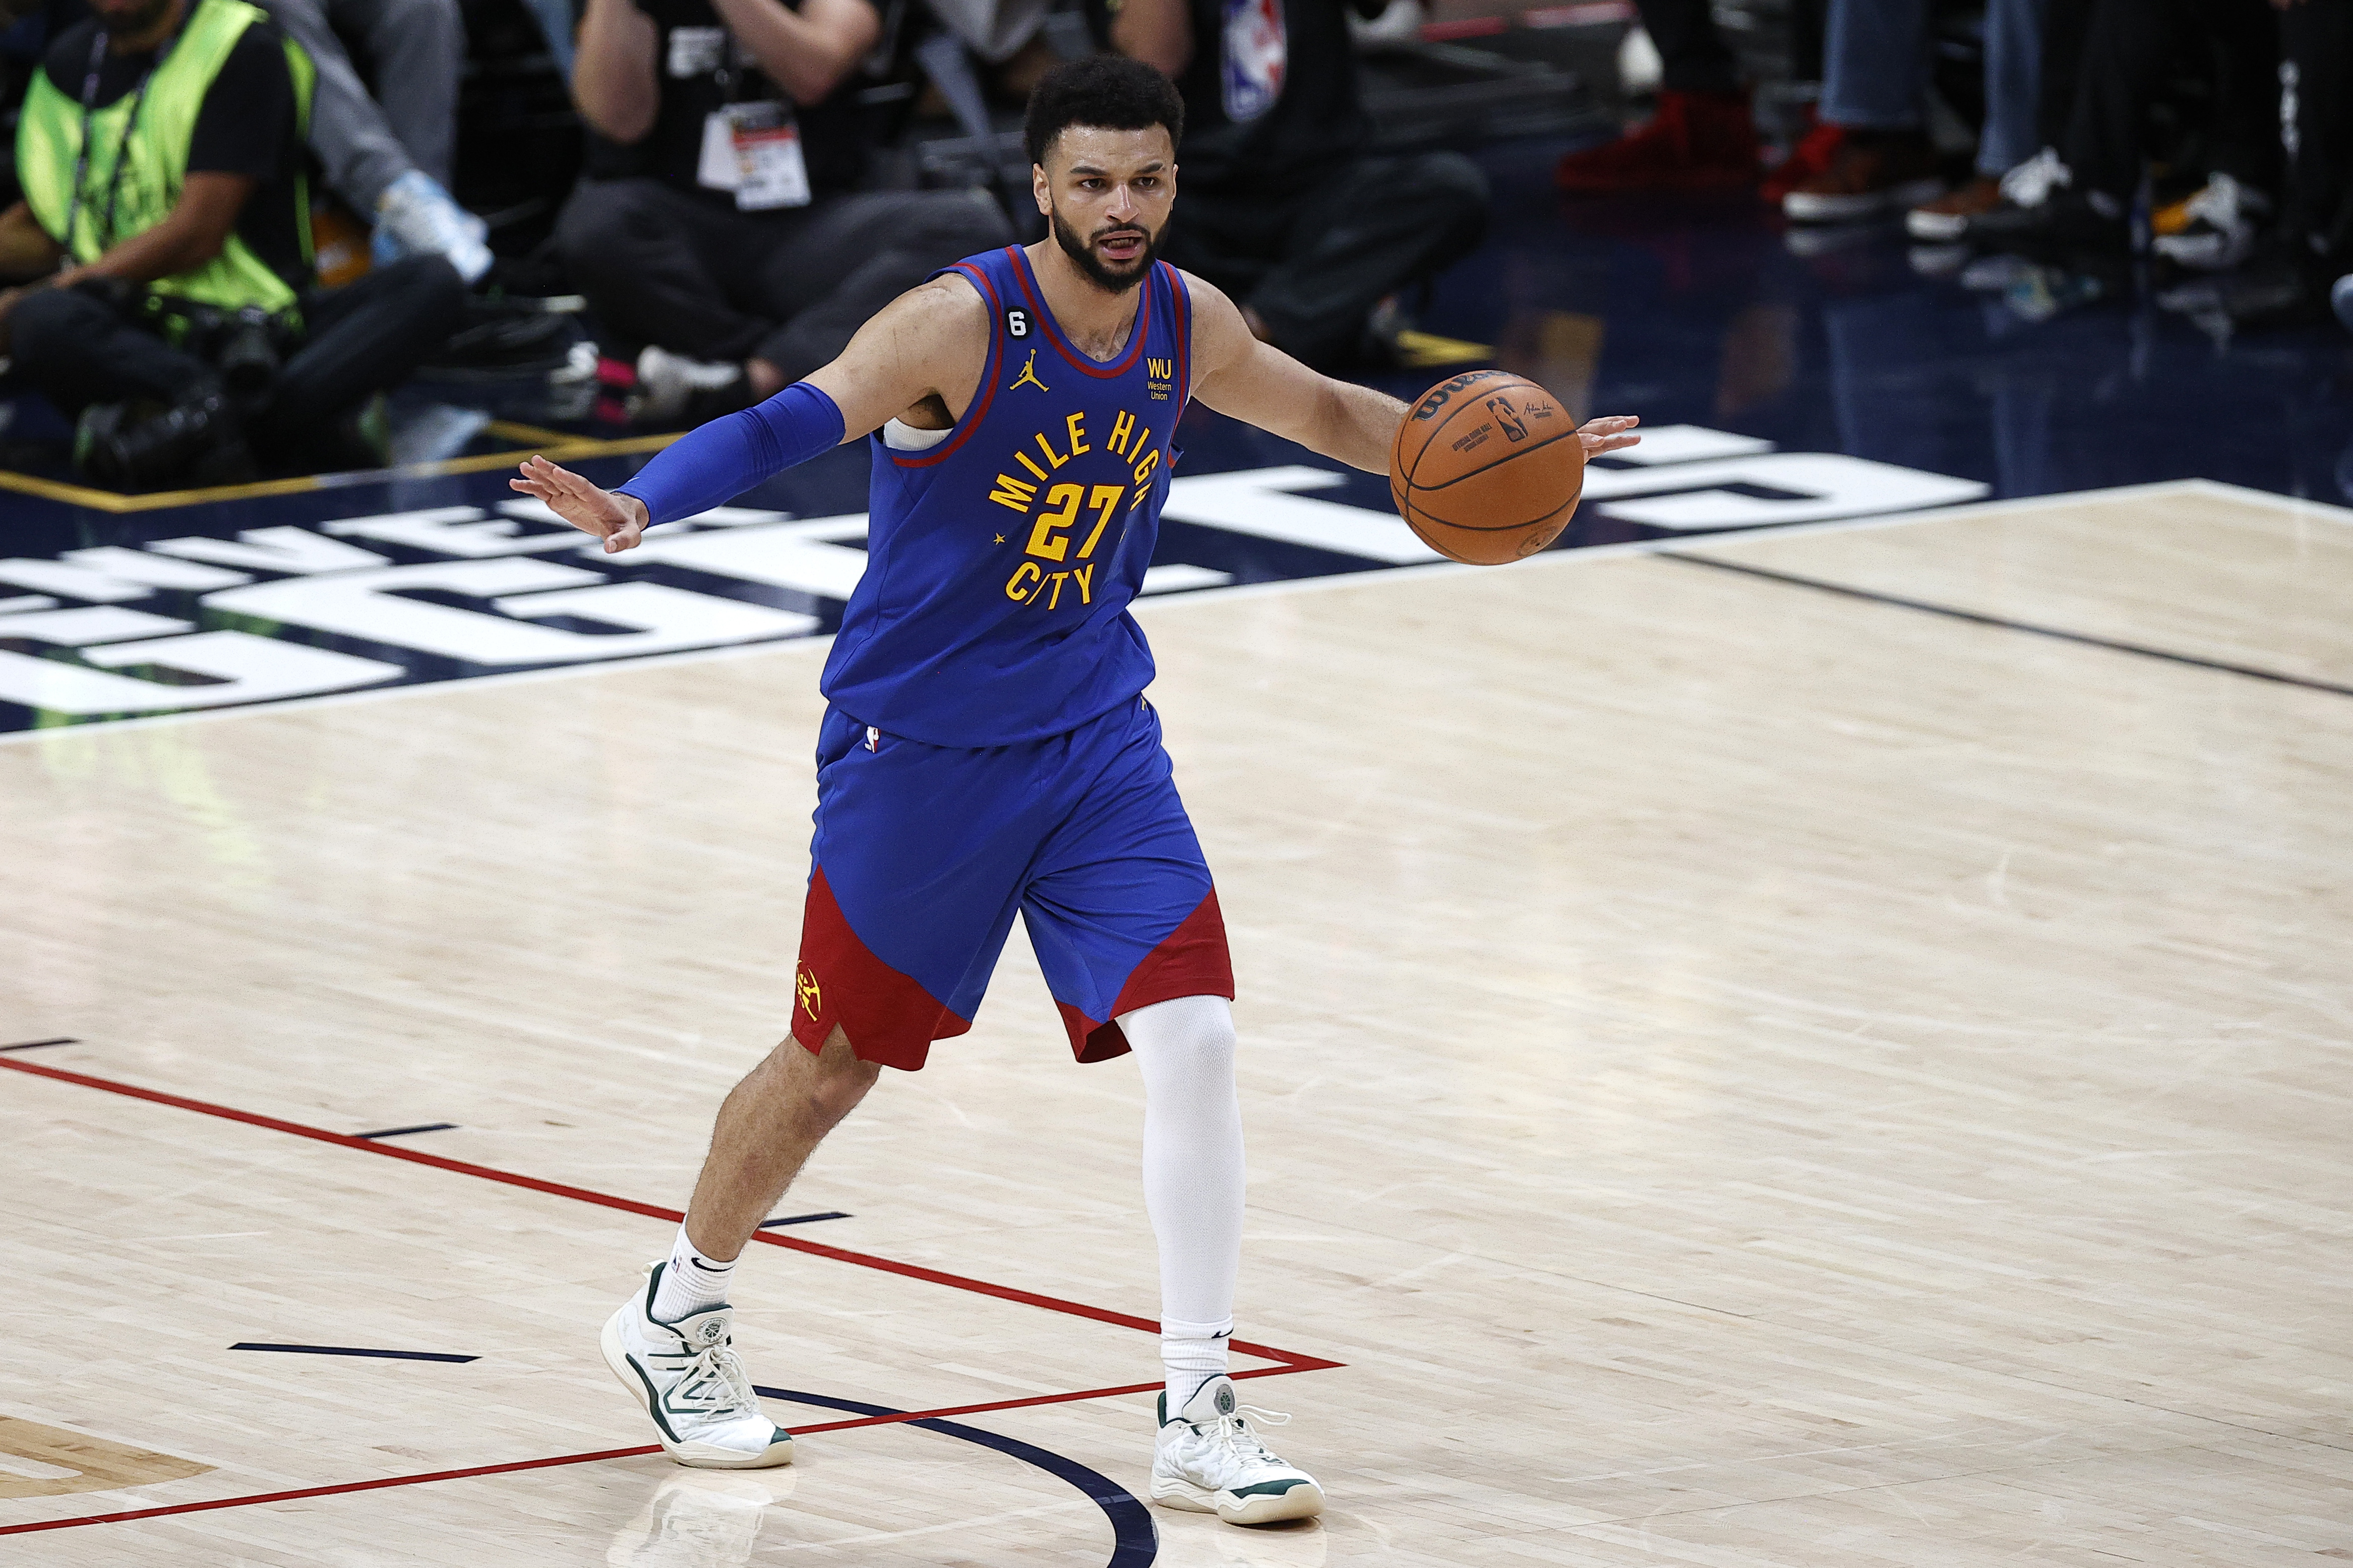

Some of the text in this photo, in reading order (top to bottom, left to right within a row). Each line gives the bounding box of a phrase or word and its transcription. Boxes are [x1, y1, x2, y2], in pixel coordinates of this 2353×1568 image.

[1008, 310, 1027, 336] 6
[1147, 357, 1172, 380] WU
[1148, 381, 1172, 391] Western
[1151, 391, 1168, 401] Union
[989, 409, 1160, 514] MILE HIGH
[1024, 481, 1126, 563] 27
[1005, 560, 1095, 611] CITY
